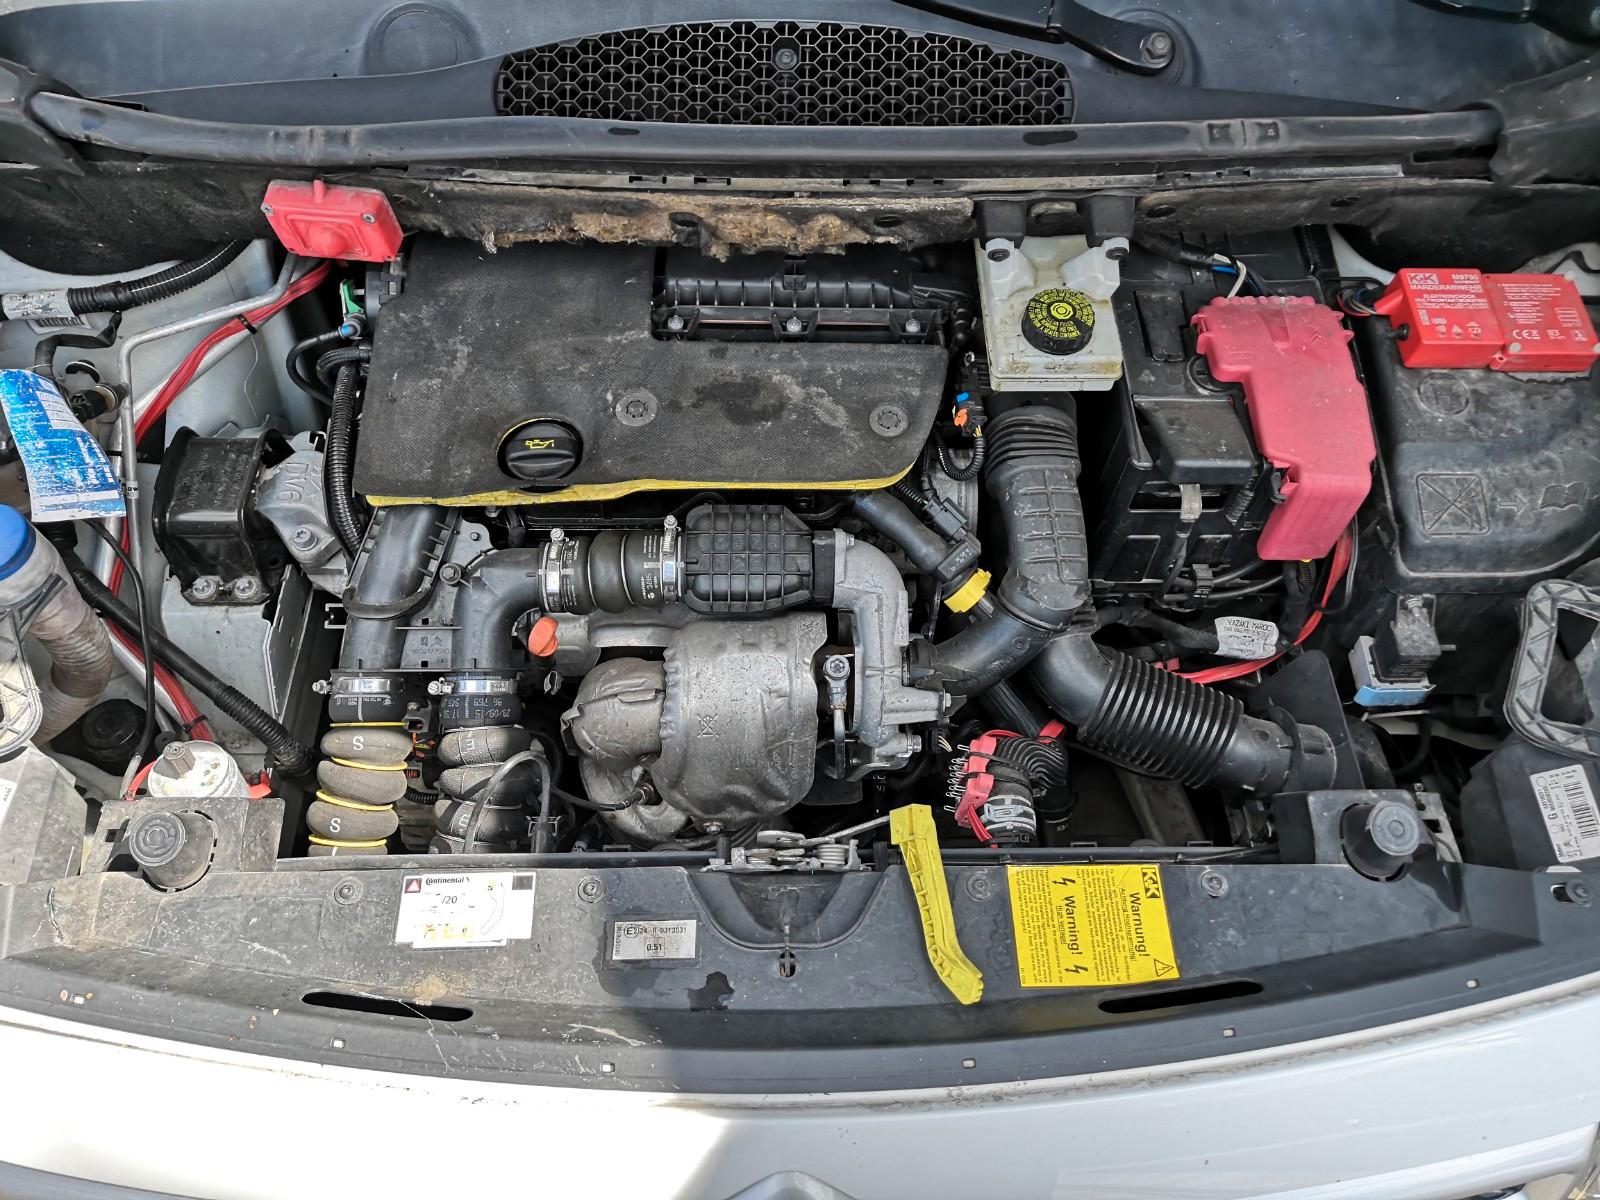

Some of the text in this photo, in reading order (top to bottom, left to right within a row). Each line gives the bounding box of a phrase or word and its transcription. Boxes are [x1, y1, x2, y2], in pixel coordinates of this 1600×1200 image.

[1408, 273, 1439, 284] K&K
[352, 736, 364, 751] S
[329, 817, 342, 833] S
[425, 876, 465, 886] Continental
[1140, 867, 1161, 898] K&K
[1120, 888, 1129, 913] Achtung
[1055, 905, 1068, 945] High Voltage!
[1064, 895, 1083, 955] Warning!
[1129, 891, 1152, 957] Warnung!
[646, 943, 662, 951] 0.51
